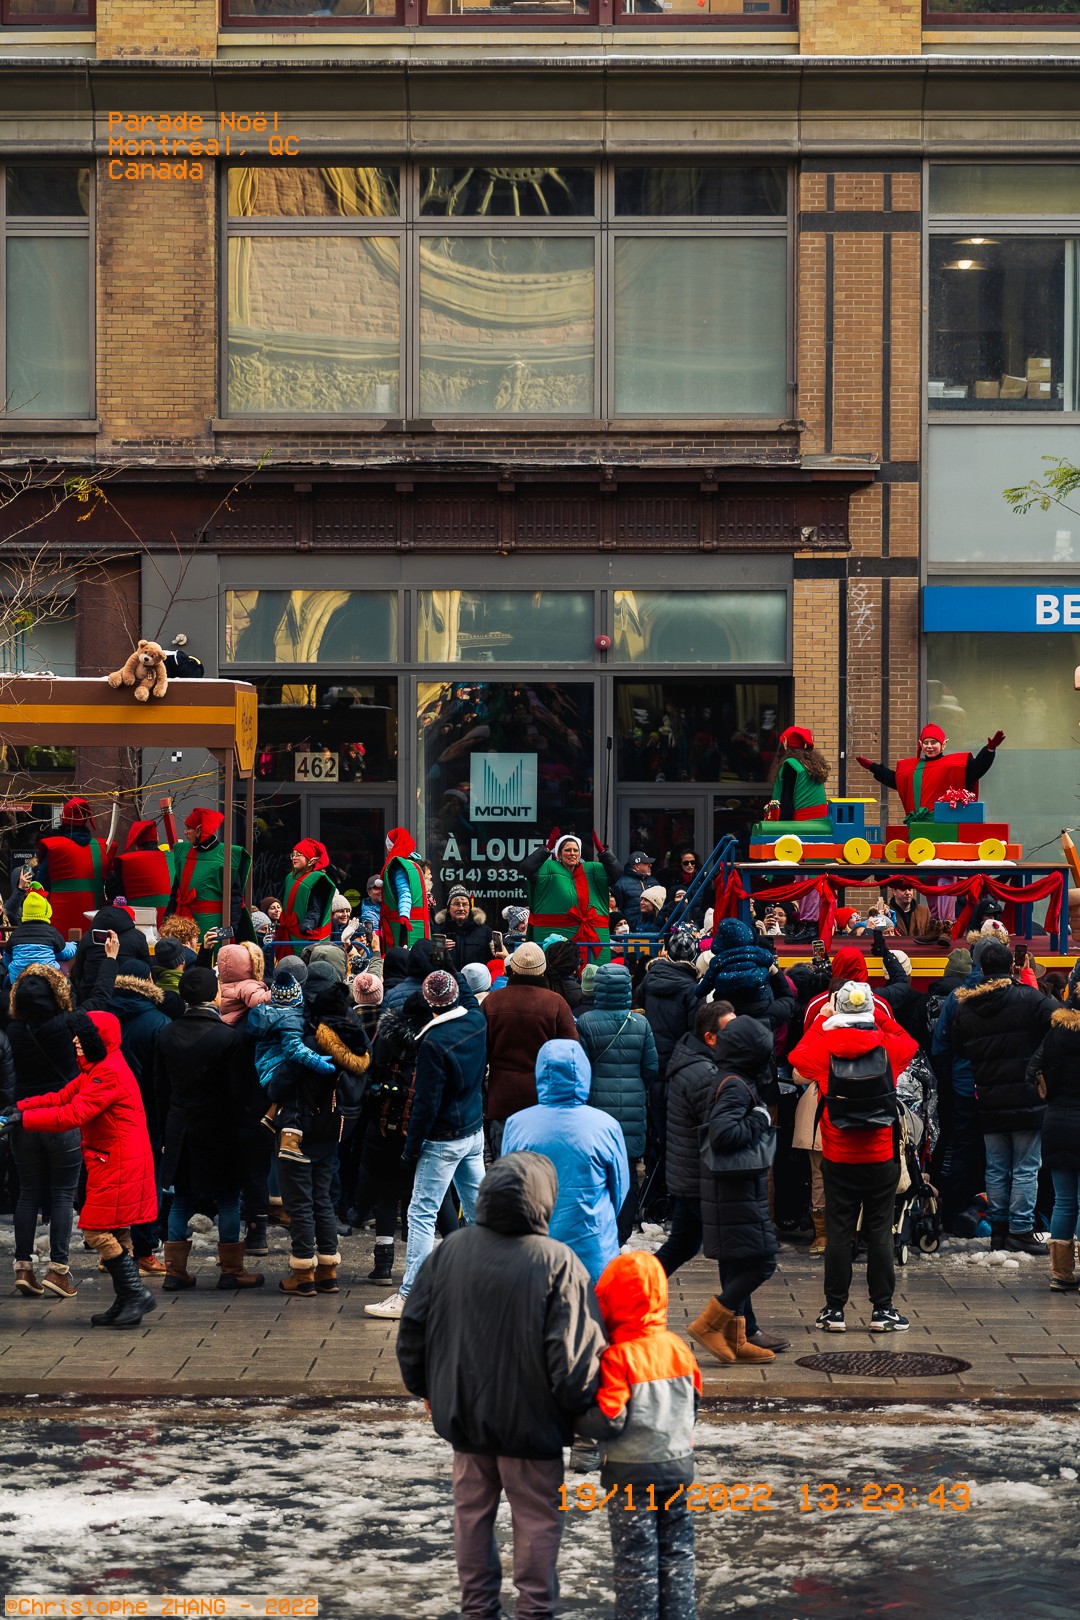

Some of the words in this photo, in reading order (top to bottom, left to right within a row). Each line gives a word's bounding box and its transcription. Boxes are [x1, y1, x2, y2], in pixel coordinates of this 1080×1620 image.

[1036, 594, 1080, 625] BE
[297, 757, 336, 778] 462
[475, 806, 532, 817] MONIT
[442, 832, 462, 861] À
[470, 838, 557, 862] LOUE
[439, 867, 482, 882] (514)
[487, 868, 528, 882] 933-
